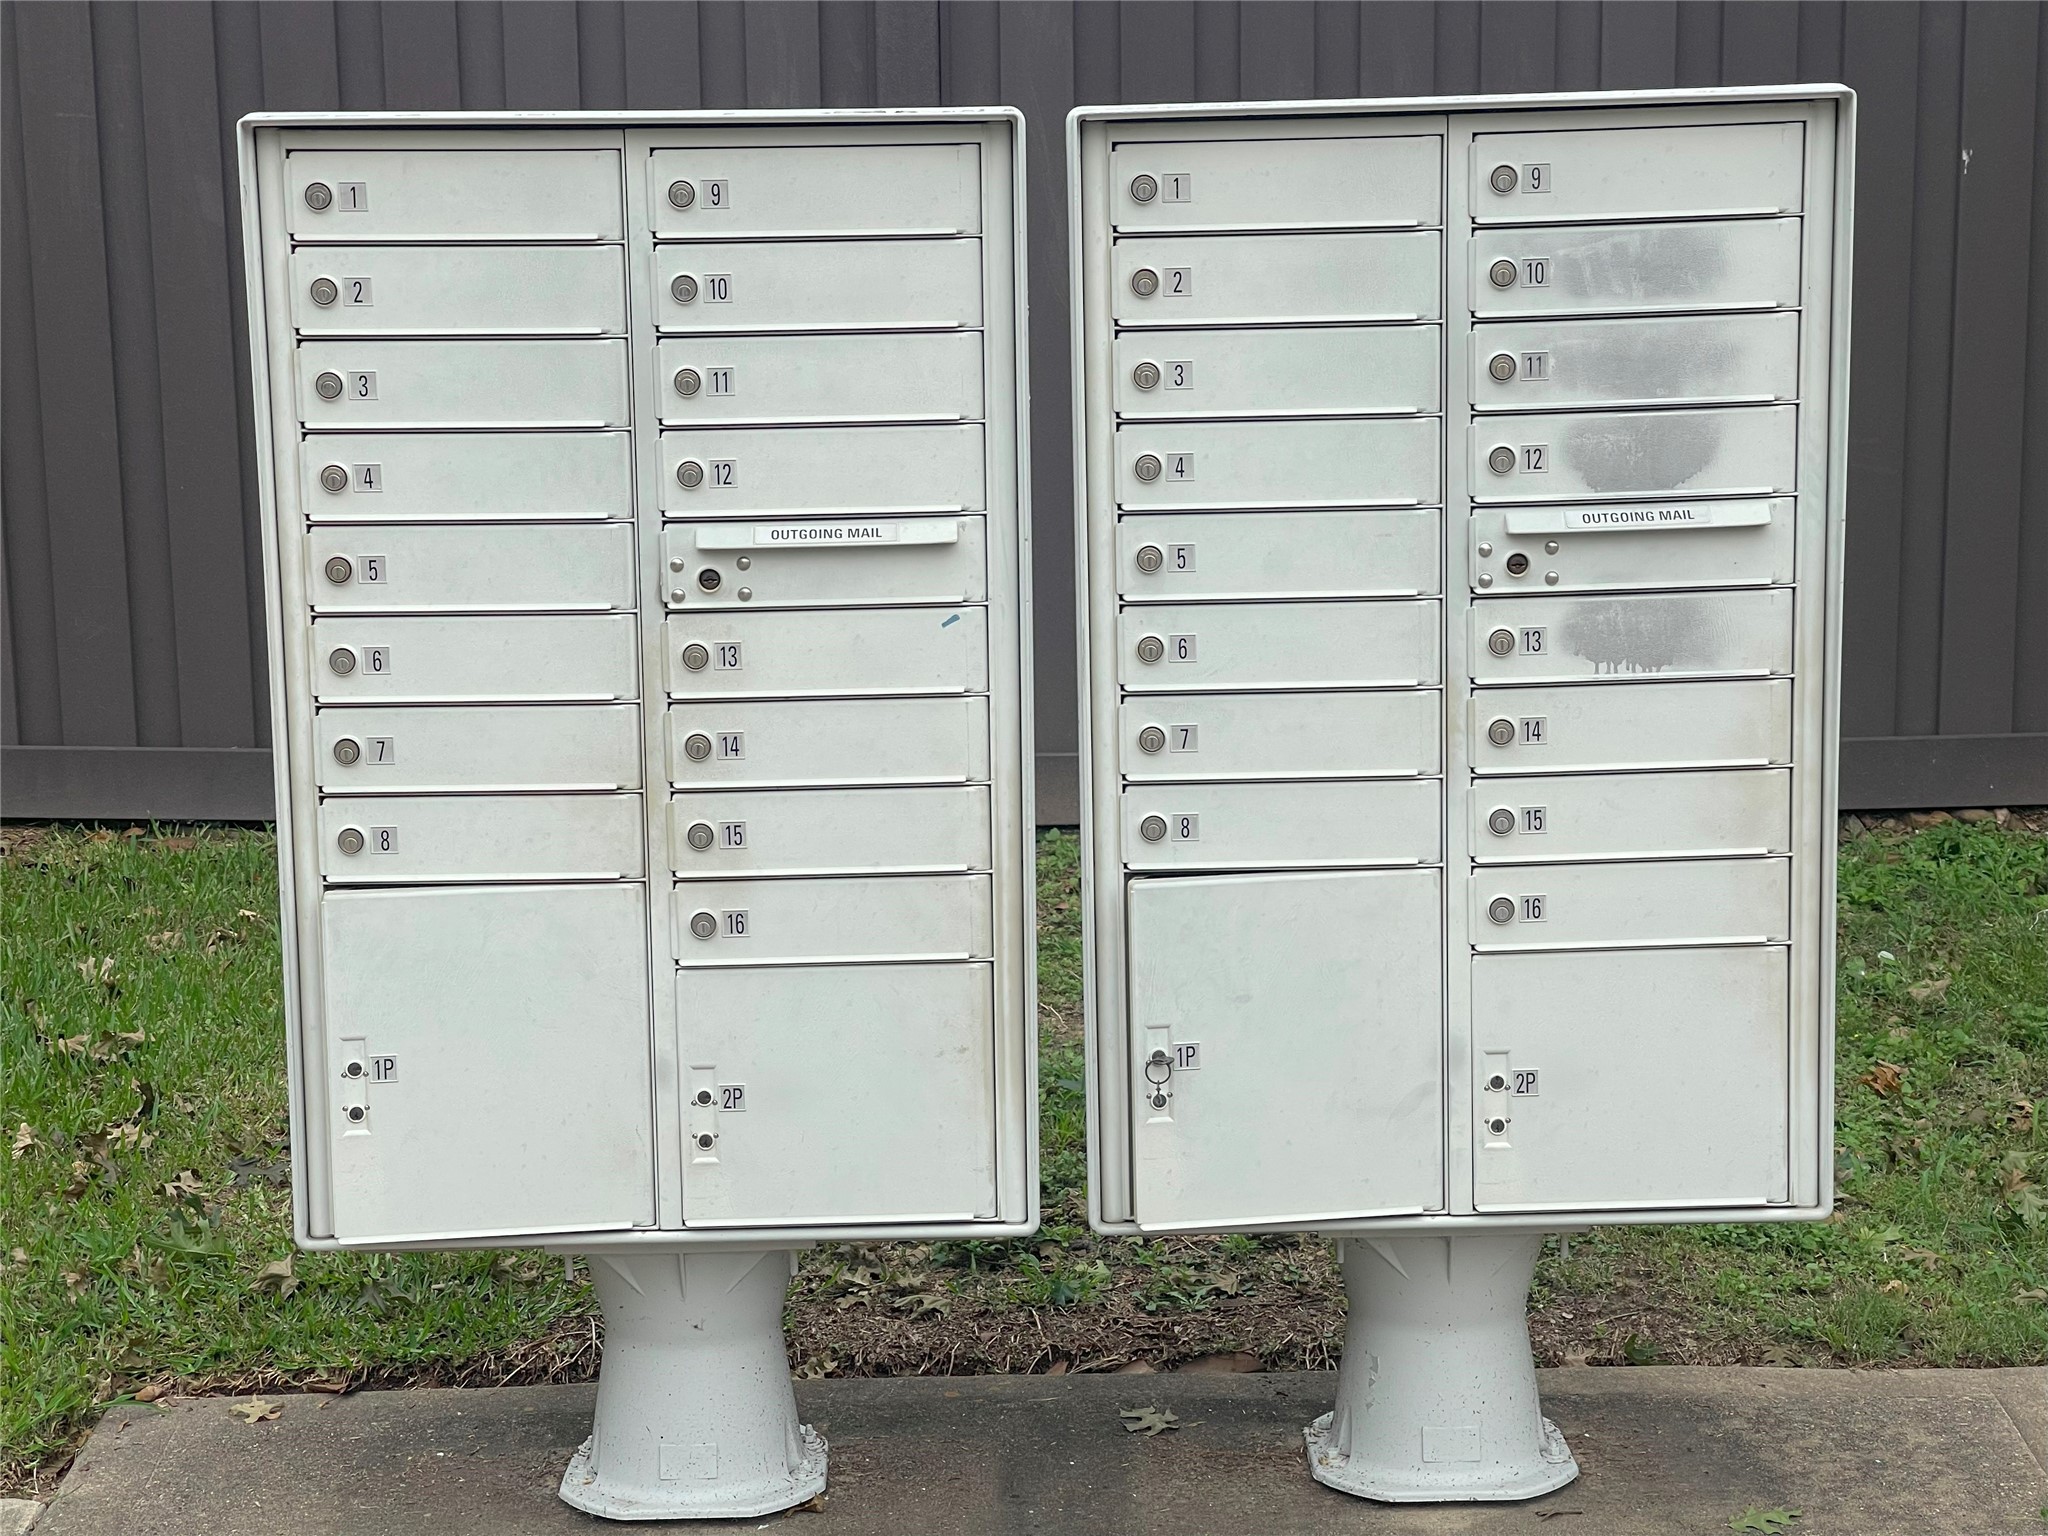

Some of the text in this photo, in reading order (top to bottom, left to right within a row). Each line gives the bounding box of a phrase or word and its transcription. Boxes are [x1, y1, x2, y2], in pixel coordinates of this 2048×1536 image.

[1172, 177, 1179, 200] 1
[1531, 167, 1541, 190] 9
[349, 186, 357, 209] 1
[711, 183, 721, 206] 9
[1173, 271, 1183, 293] 2
[1527, 262, 1544, 284] 10
[353, 281, 363, 303] 2
[709, 277, 728, 300] 10
[1174, 364, 1184, 387] 3
[1527, 355, 1542, 376] 11
[358, 375, 369, 397] 3
[712, 371, 728, 393] 11
[1175, 456, 1185, 478] 4
[1525, 448, 1543, 470] 12
[363, 467, 374, 489] 4
[714, 463, 732, 485] 12
[1582, 509, 1695, 524] OUTGOING MAIL
[771, 527, 883, 540] OUTGOING MAIL
[1177, 547, 1186, 570] 5
[368, 559, 378, 581] 5
[1178, 637, 1188, 660] 6
[1524, 630, 1542, 652] 13
[372, 650, 382, 672] 6
[720, 645, 738, 667] 13
[1180, 728, 1189, 750] 7
[1524, 720, 1542, 742] 14
[376, 740, 385, 762] 7
[722, 736, 740, 757] 14
[1181, 817, 1190, 839] 8
[1525, 809, 1543, 831] 15
[380, 830, 390, 851] 8
[725, 824, 743, 846] 15
[1524, 897, 1541, 919] 16
[727, 913, 745, 935] 16
[1177, 1045, 1196, 1068] 1P
[374, 1058, 394, 1081] 1P
[1516, 1072, 1536, 1094] 2P
[723, 1087, 743, 1109] 2P
